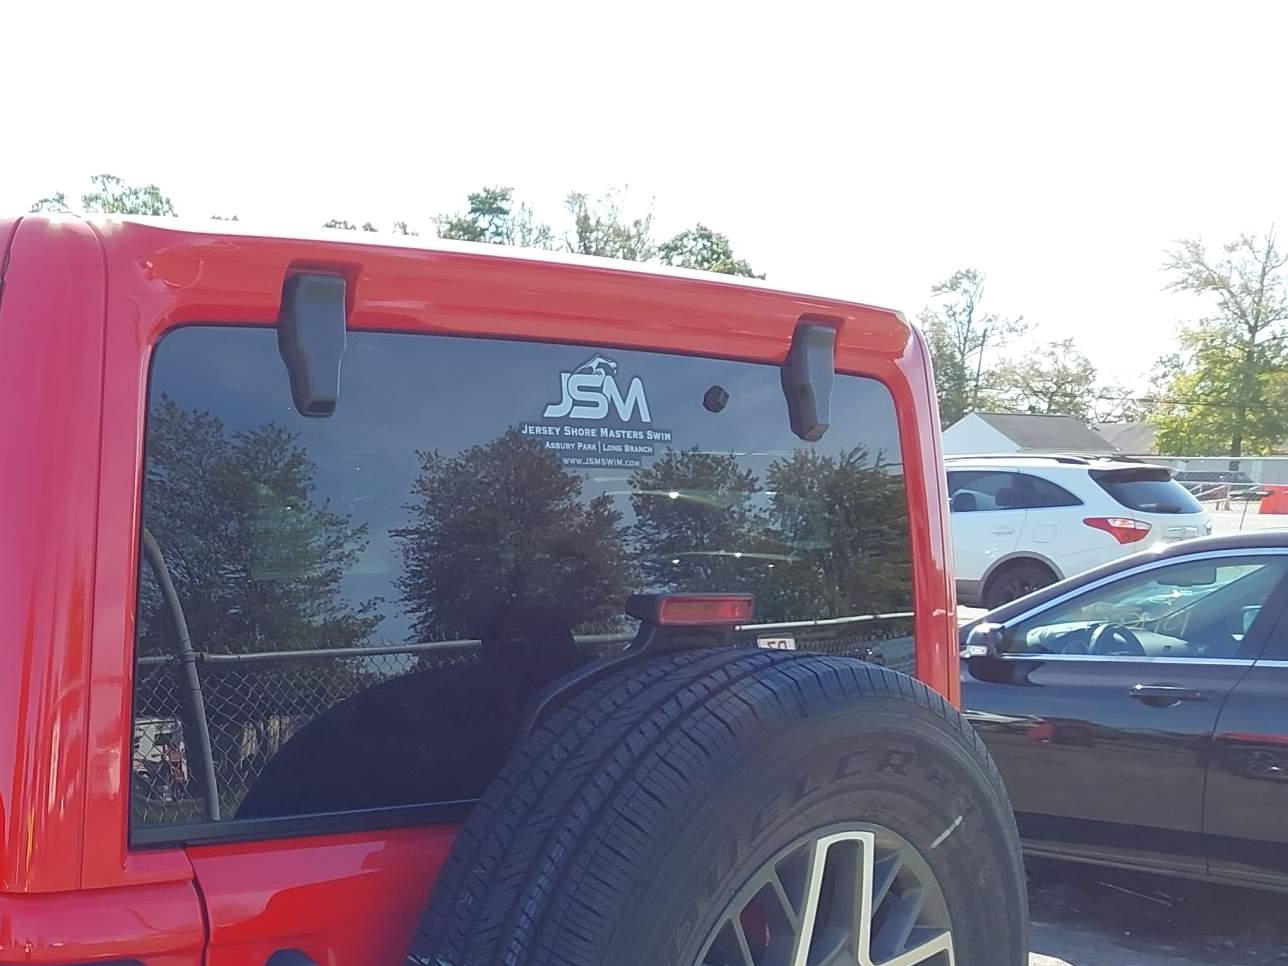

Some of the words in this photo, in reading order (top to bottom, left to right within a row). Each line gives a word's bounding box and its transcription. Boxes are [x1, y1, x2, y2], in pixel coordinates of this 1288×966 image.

[543, 371, 652, 422] JSM
[521, 424, 561, 436] JERSEY
[564, 426, 597, 437] SHORE
[600, 428, 644, 440] MASTERS
[646, 430, 672, 441] SWIM
[545, 440, 575, 450] ASBURY
[577, 442, 597, 451] PARK
[602, 444, 623, 452] LONG
[624, 444, 653, 453] BRANCH
